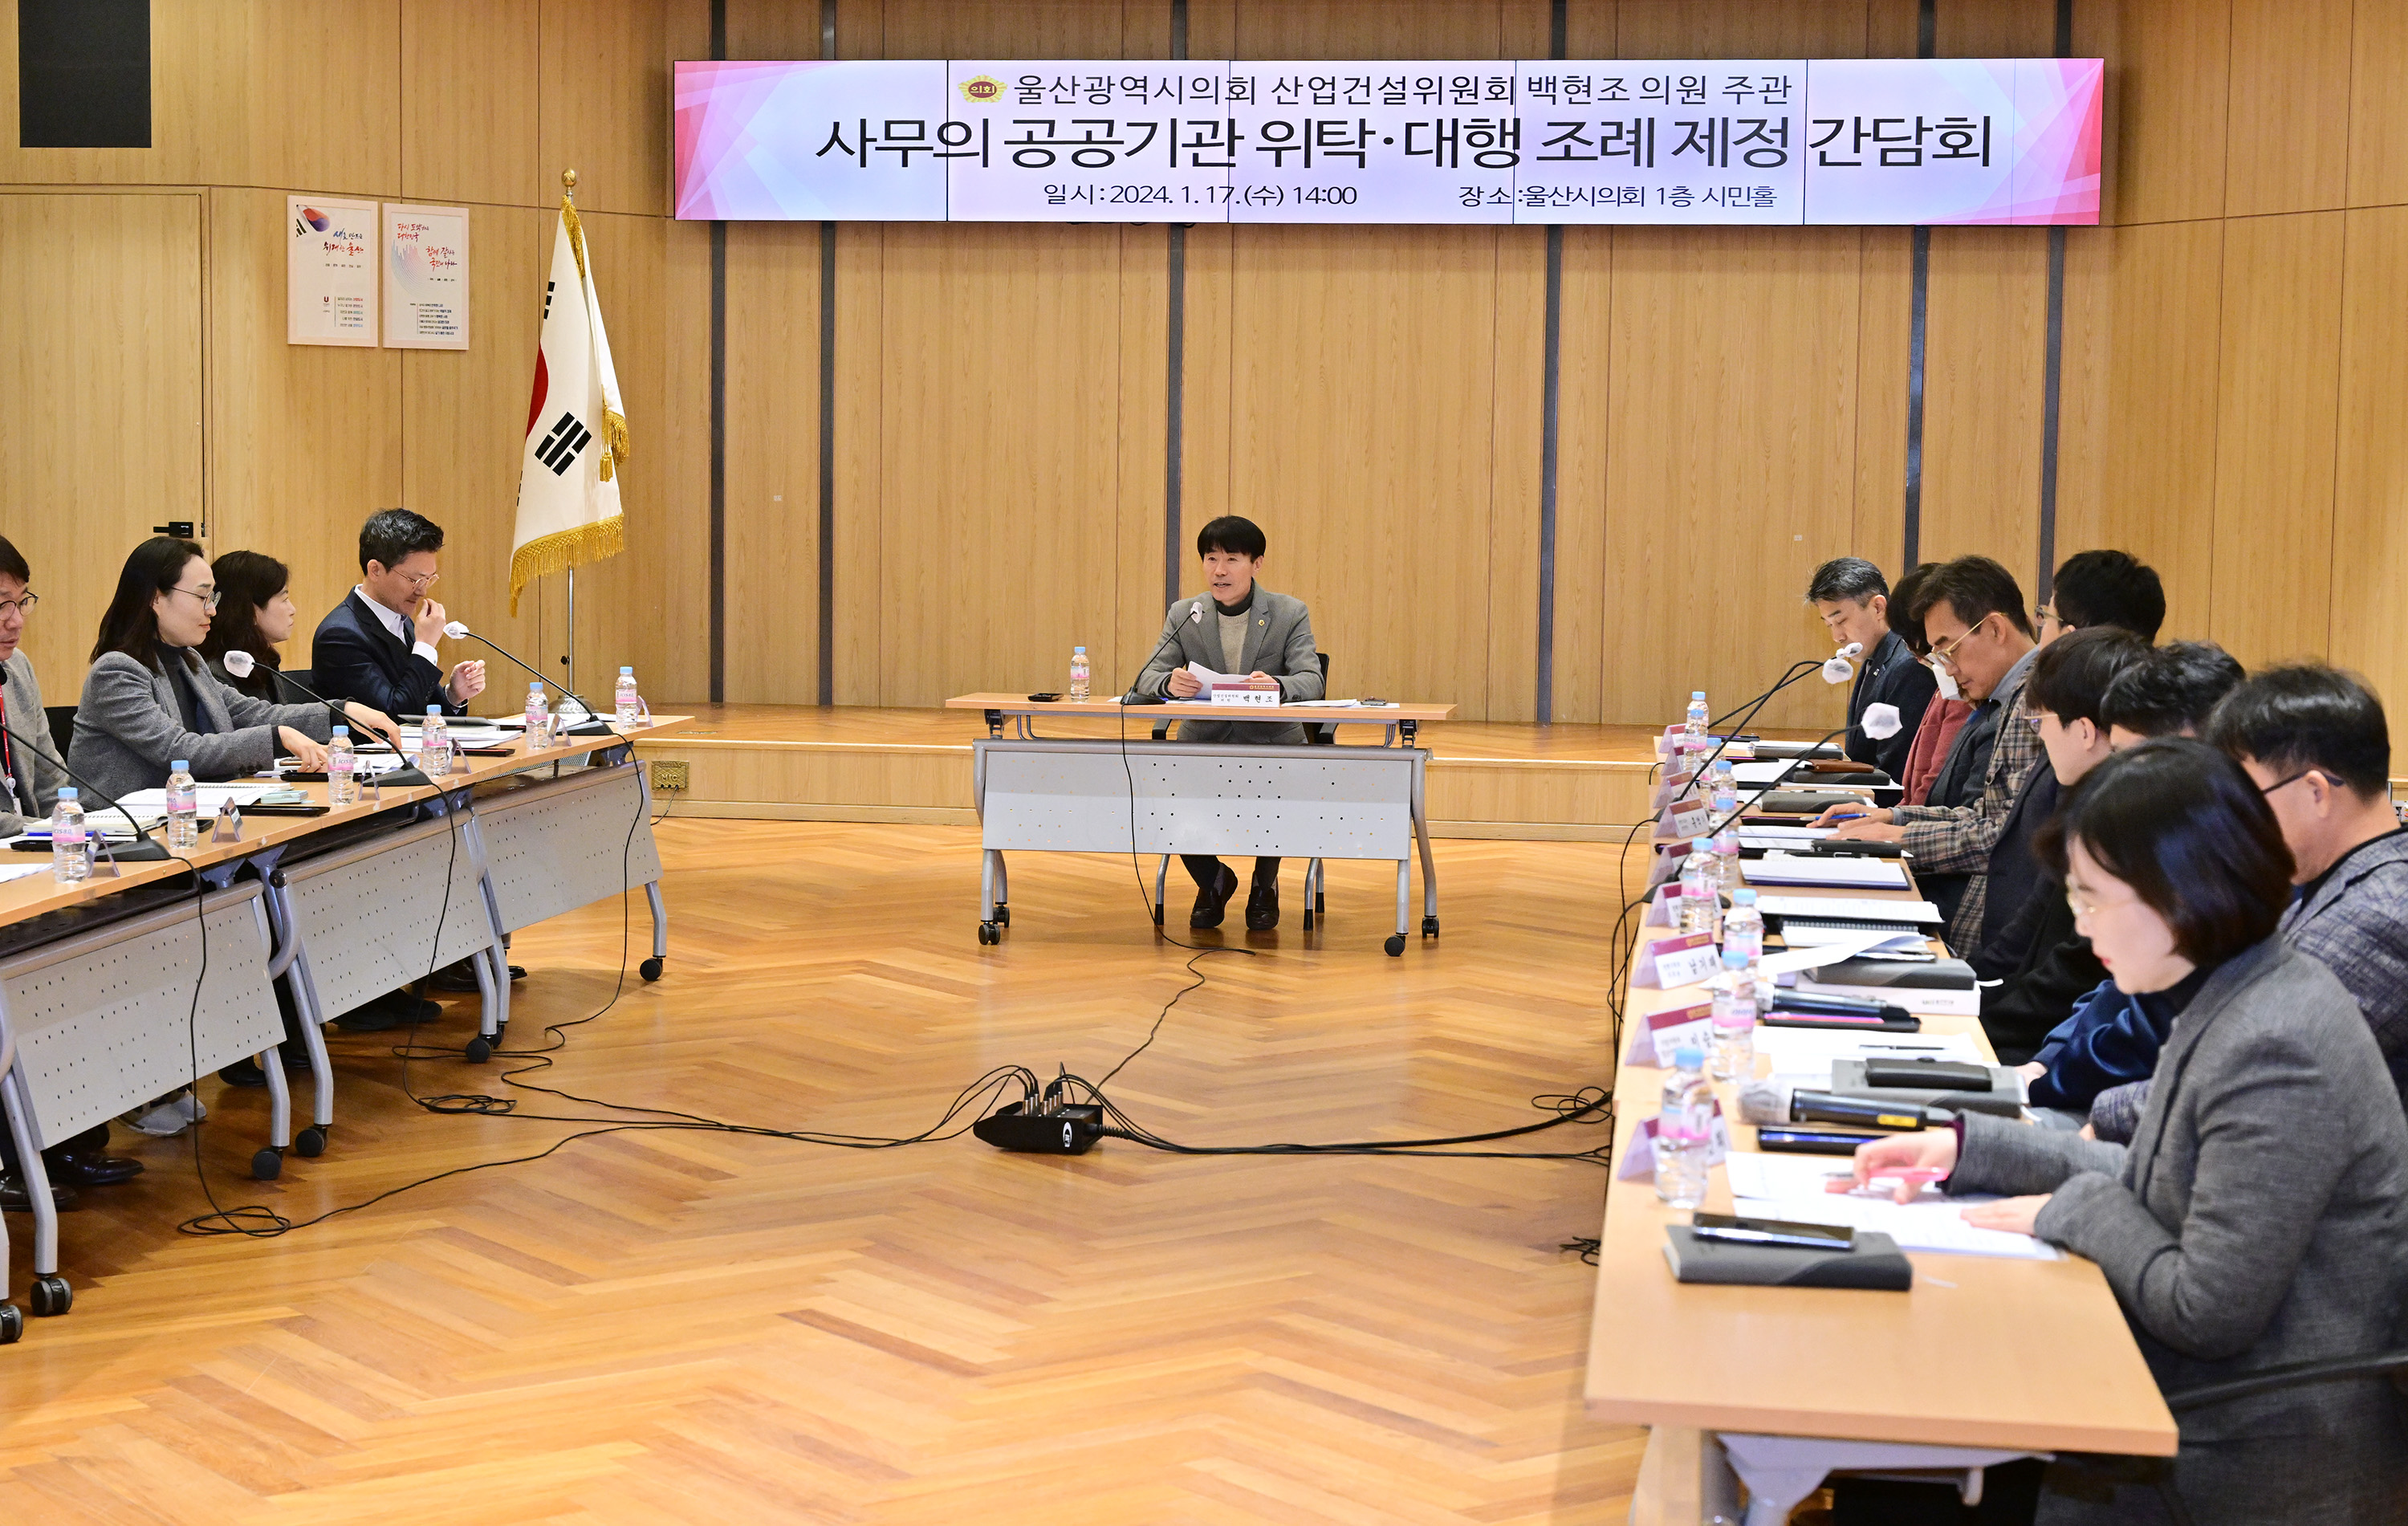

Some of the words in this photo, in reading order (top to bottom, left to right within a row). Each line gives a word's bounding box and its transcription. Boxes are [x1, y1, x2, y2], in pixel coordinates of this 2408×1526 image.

[970, 85, 995, 94] 의회
[1014, 75, 1257, 106] 울산광역시의회
[1271, 75, 1515, 106] 산업건설위원회
[1527, 75, 1631, 105] 백현조
[1639, 75, 1706, 105] 의원
[1721, 75, 1793, 104] 주관
[816, 117, 990, 169] 사무의
[1003, 117, 1245, 169] 공공기관
[1255, 117, 1521, 169] 위탁·대행
[1536, 118, 1656, 168] 조례
[1670, 116, 1789, 168] 제정
[1808, 116, 1991, 168] 간담회
[1182, 185, 1199, 204] 1.
[1293, 186, 1357, 205] 14:00
[1657, 185, 1695, 207] 1층
[1702, 185, 1777, 208] 시민홀
[661, 773, 678, 782] MIC
